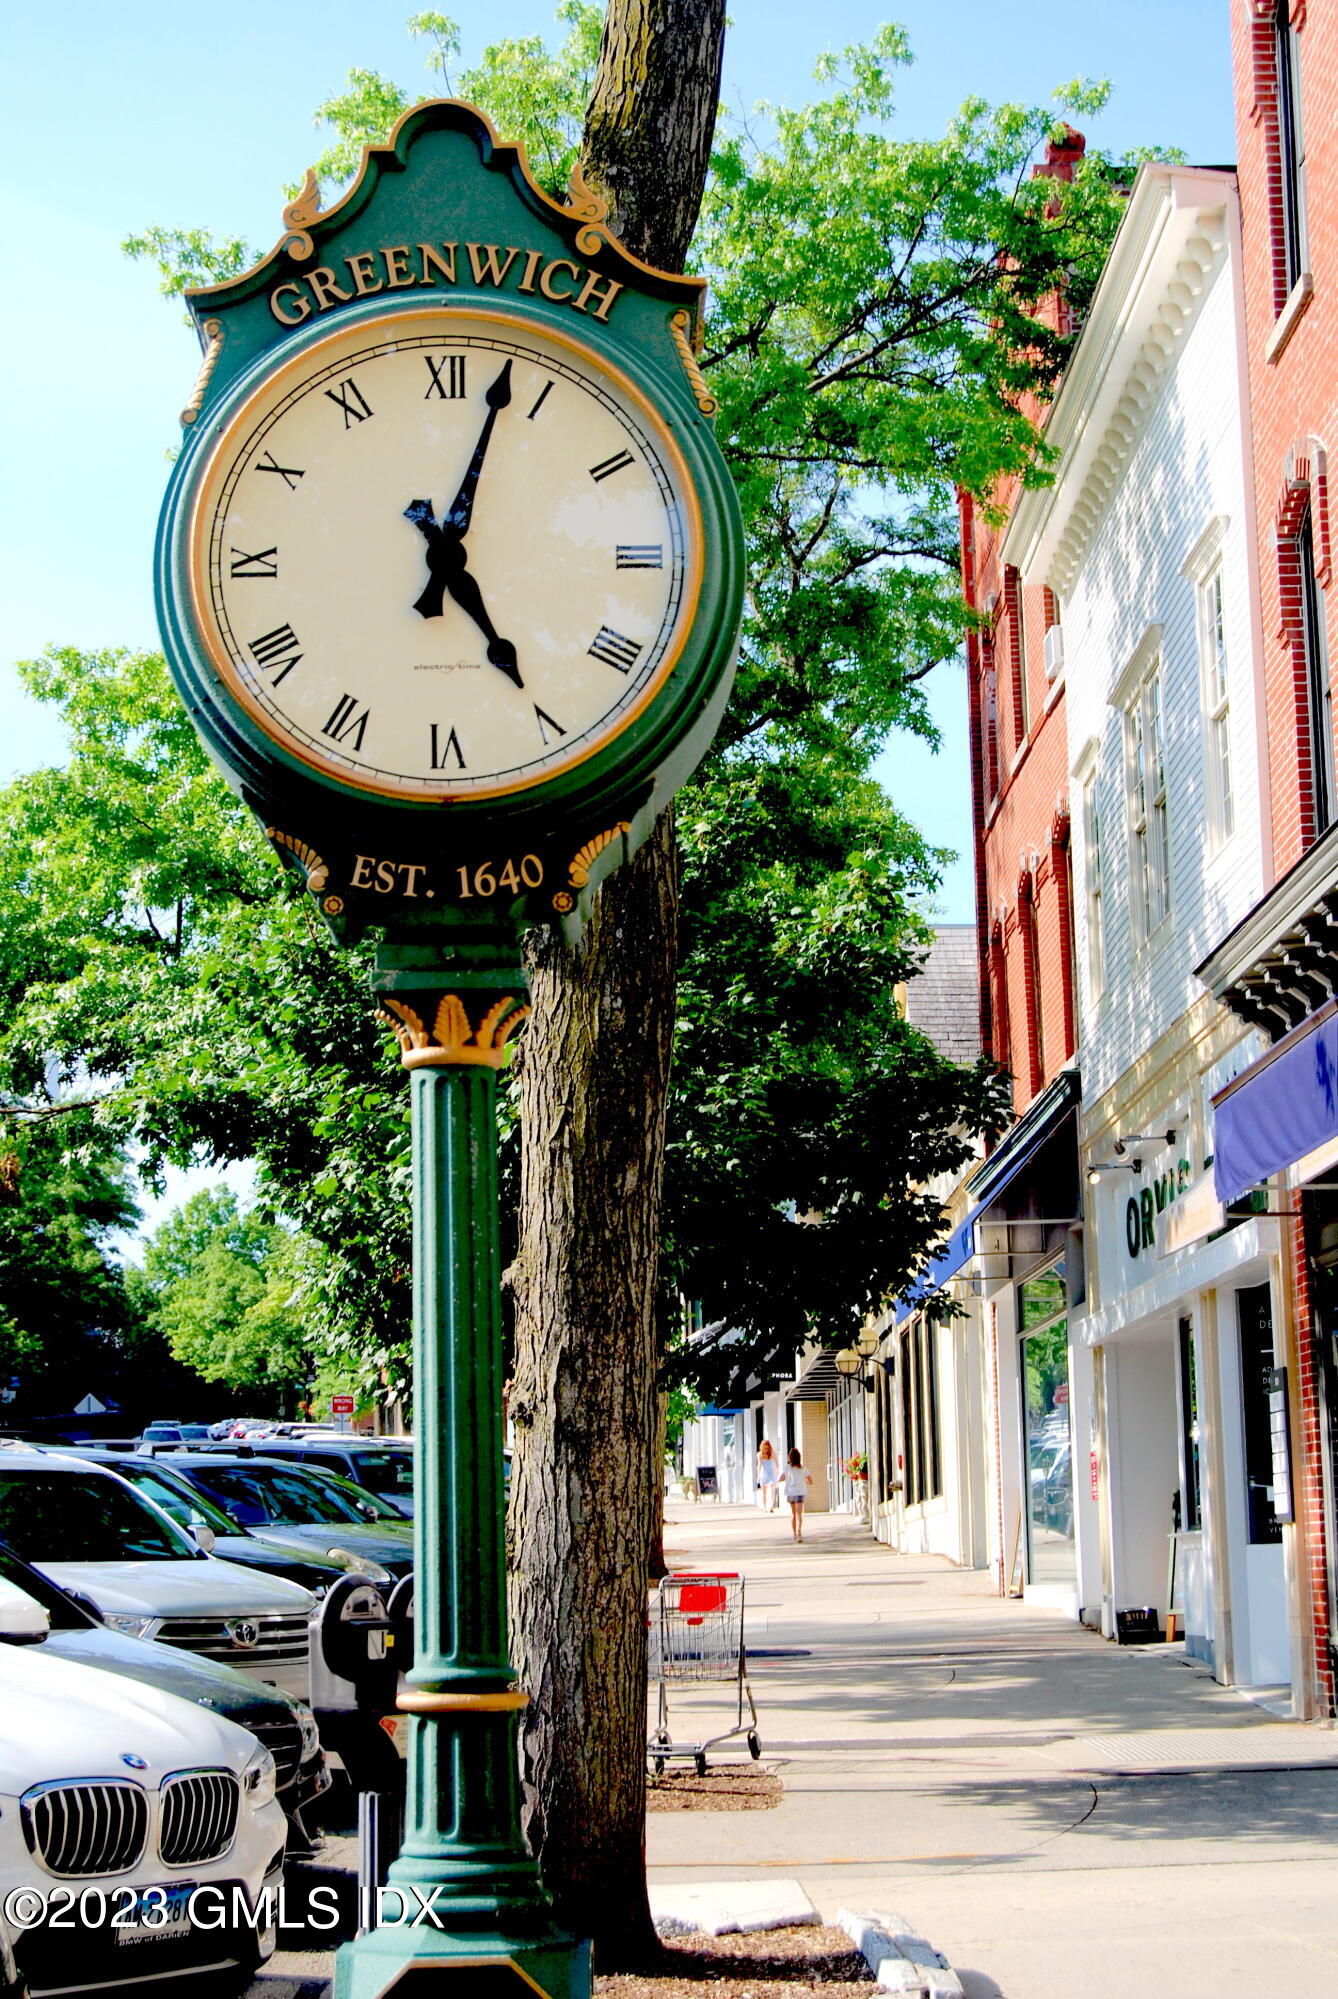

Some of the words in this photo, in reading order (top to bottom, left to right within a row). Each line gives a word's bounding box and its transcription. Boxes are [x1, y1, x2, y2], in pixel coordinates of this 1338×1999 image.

[269, 241, 624, 325] GREENWICH
[424, 355, 466, 399] XII
[324, 377, 374, 430] XI
[527, 380, 555, 420] I
[254, 450, 305, 491] X
[589, 448, 636, 483] II
[231, 547, 278, 579] IX
[616, 545, 662, 570] III
[248, 623, 305, 688] VIII
[587, 625, 644, 676] IIII
[321, 693, 370, 752] VII
[533, 702, 567, 745] V
[430, 724, 467, 769] VI
[350, 855, 434, 899] EST.
[457, 854, 544, 898] 1640
[119, 1937, 142, 1947] BMW
[156, 1931, 190, 1941] DARIEN
